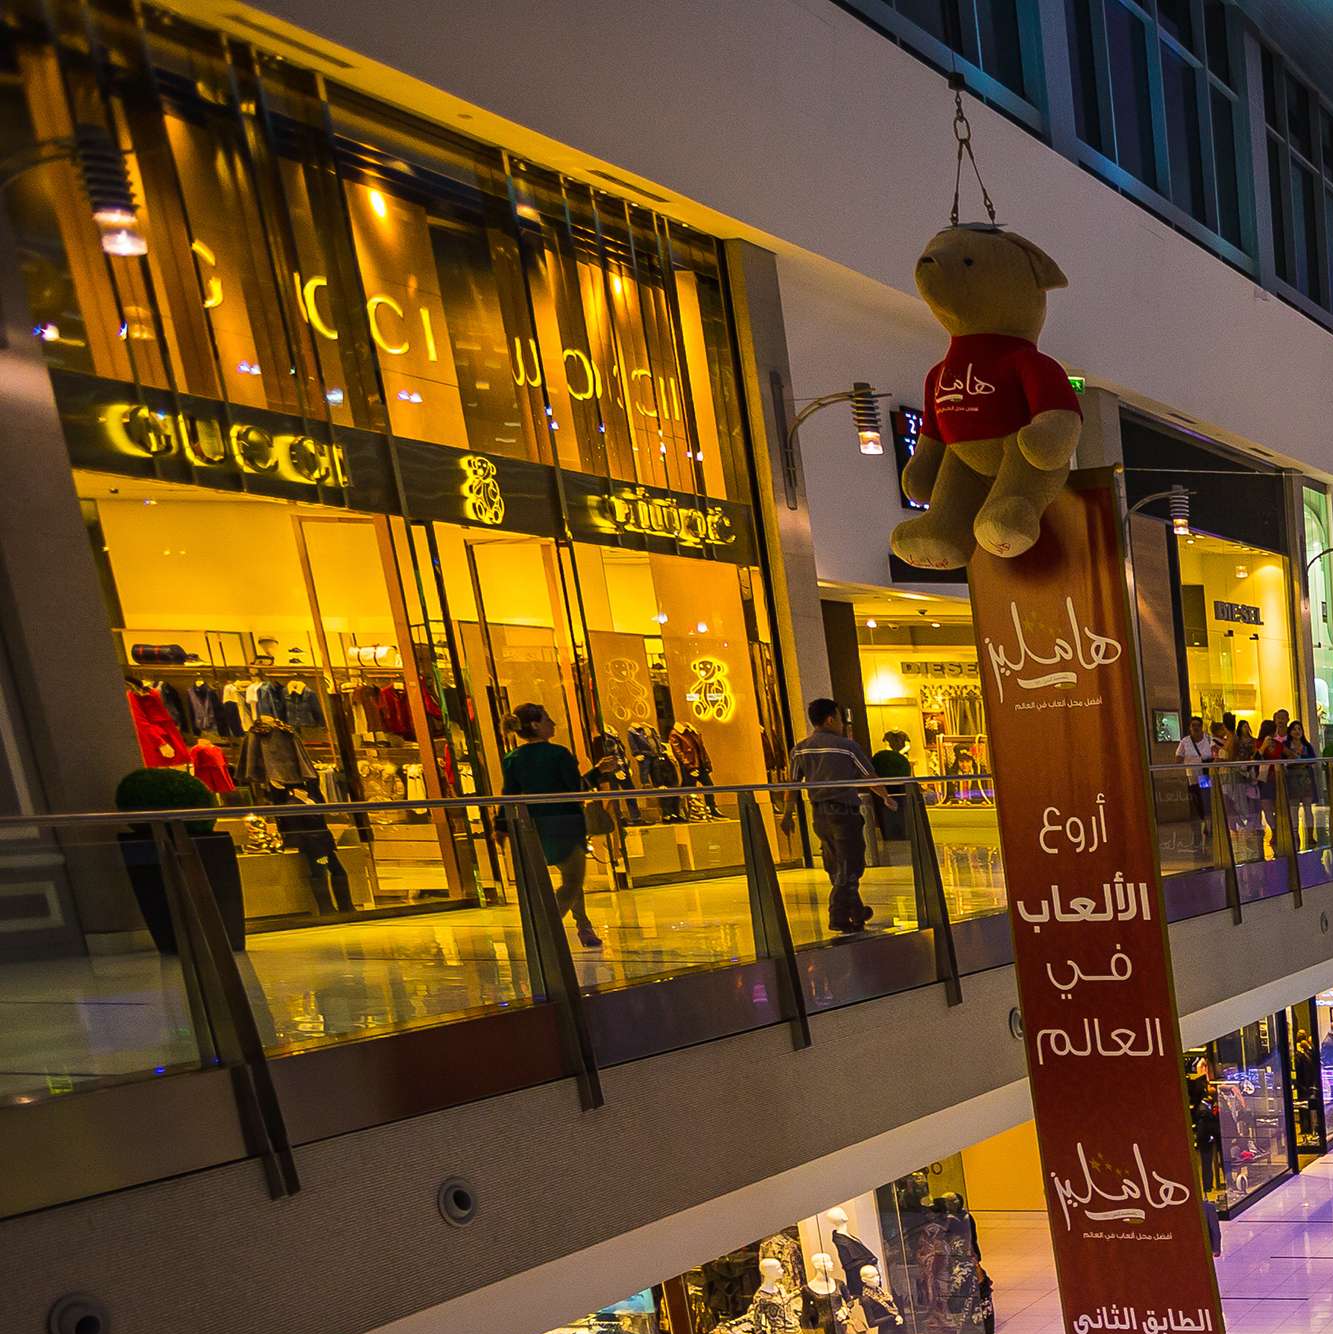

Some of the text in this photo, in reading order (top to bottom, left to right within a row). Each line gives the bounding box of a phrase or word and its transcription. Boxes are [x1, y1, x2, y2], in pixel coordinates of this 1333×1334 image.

[112, 403, 352, 488] GUCCI
[1214, 601, 1264, 625] DIESEL
[901, 662, 979, 679] DIESE
[984, 596, 1121, 703] هامليز
[1039, 792, 1108, 855] أروع
[1017, 870, 1151, 925] الألعاب
[1046, 946, 1133, 999] في
[1036, 1017, 1164, 1066] العالم
[1050, 1142, 1190, 1232] هامليز
